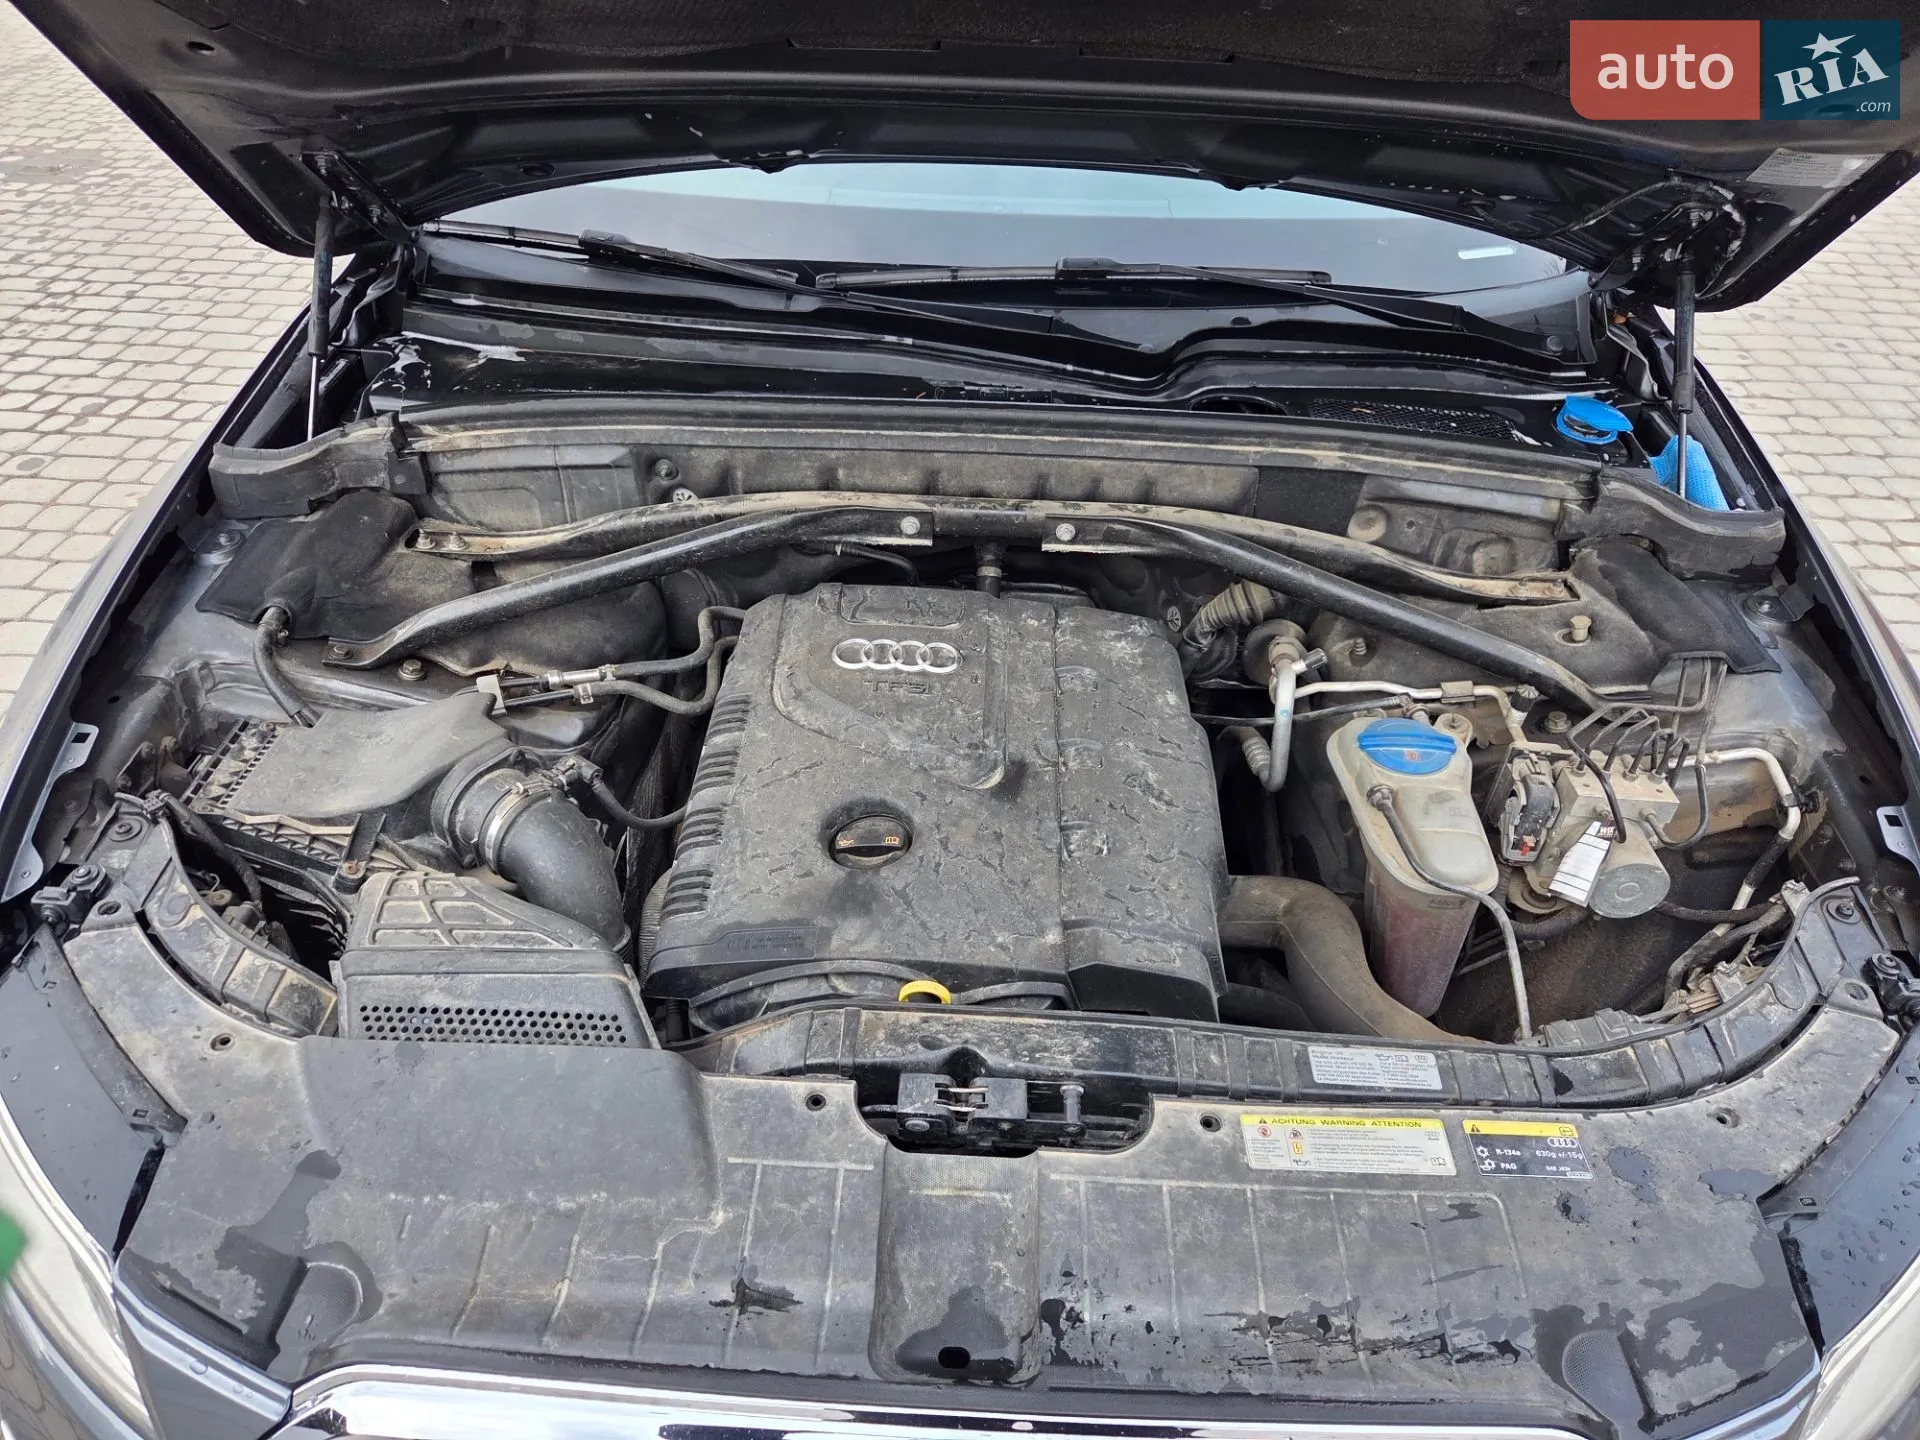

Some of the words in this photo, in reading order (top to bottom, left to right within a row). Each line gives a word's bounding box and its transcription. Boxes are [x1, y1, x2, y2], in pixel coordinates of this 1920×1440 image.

[1371, 1120, 1422, 1128] ATTENTION
[1495, 1148, 1521, 1156] R-134a
[1535, 1150, 1557, 1158] 630g
[1499, 1162, 1518, 1170] PAG
